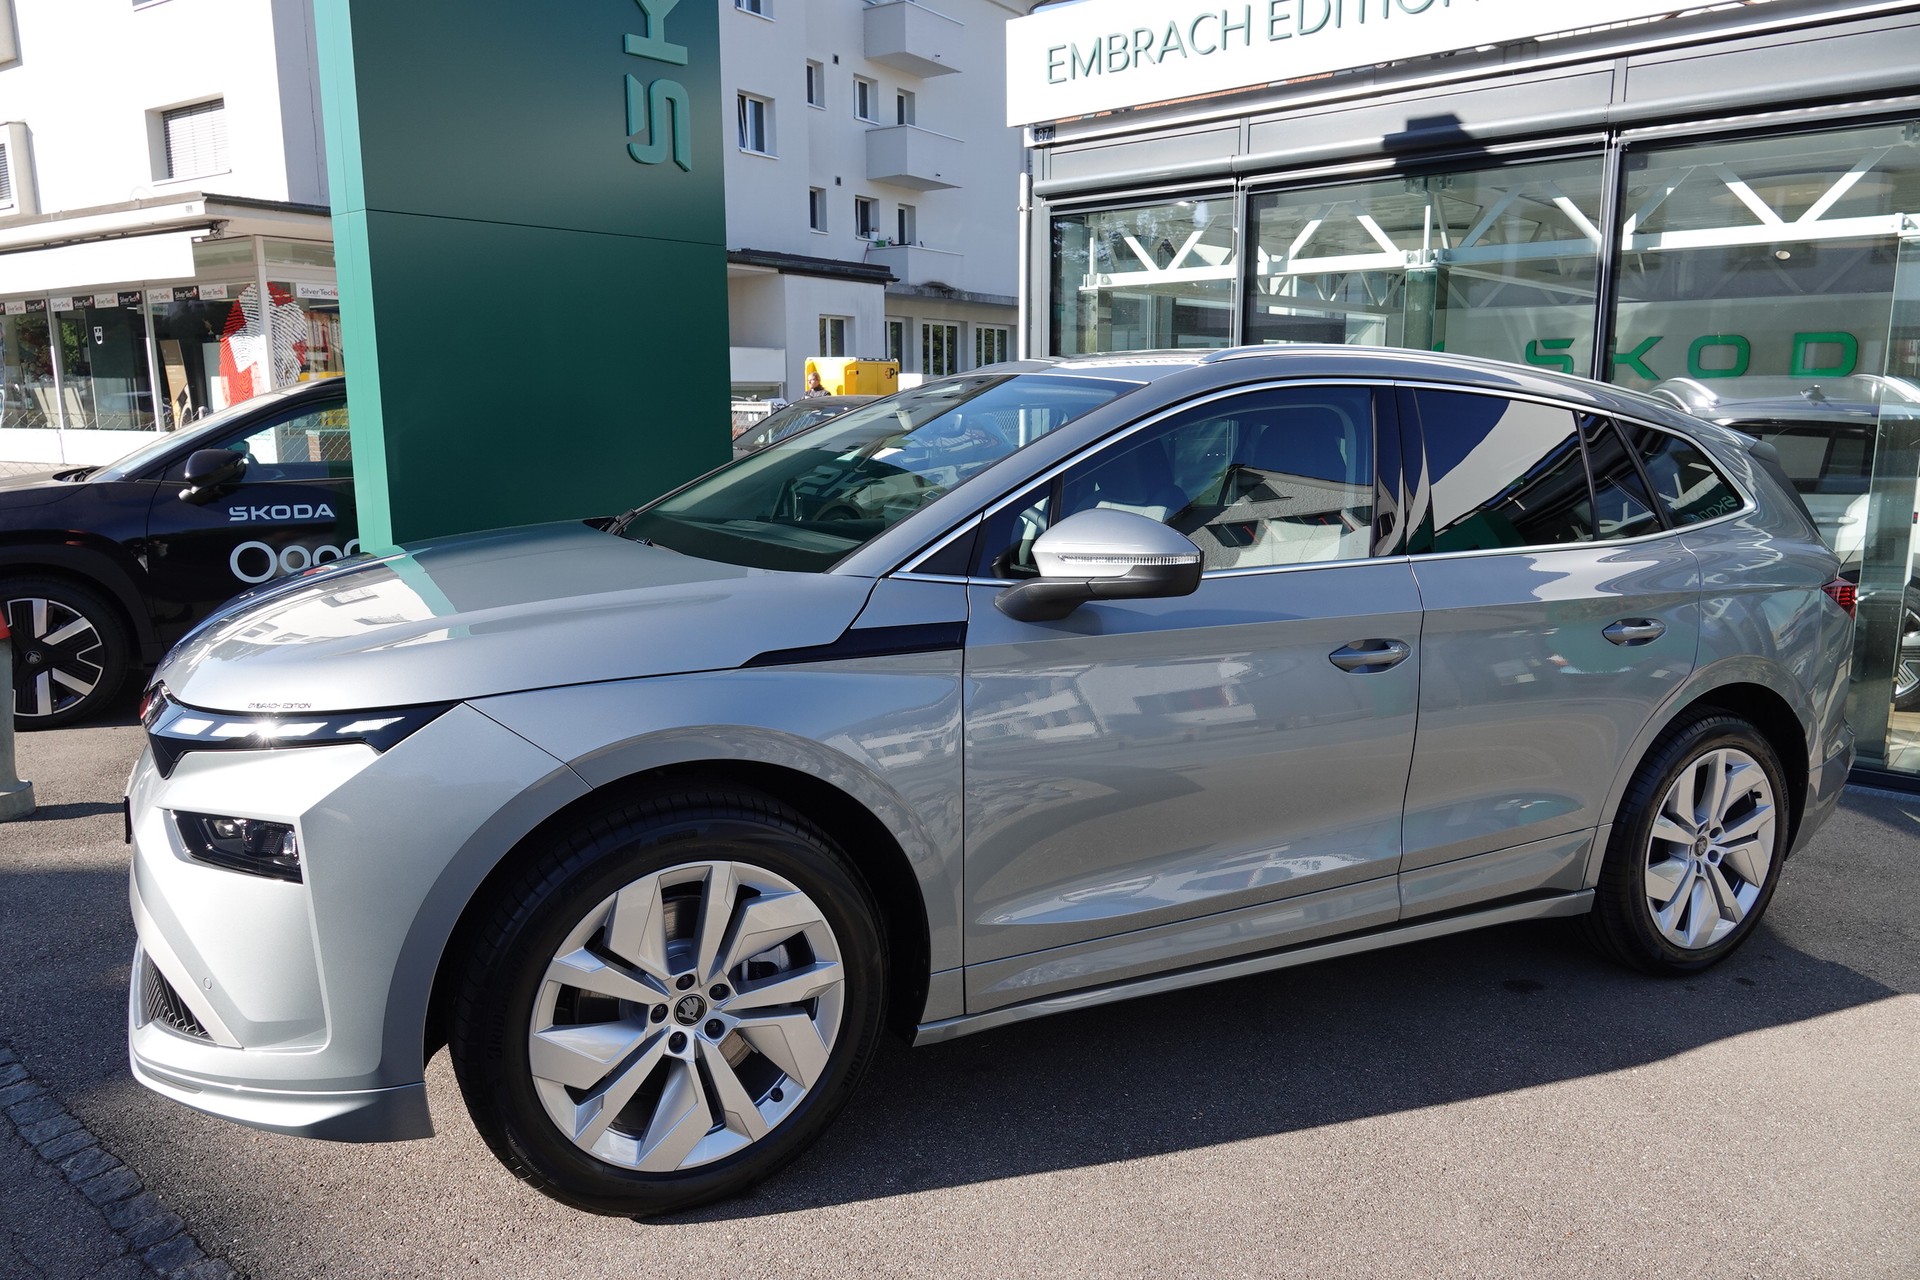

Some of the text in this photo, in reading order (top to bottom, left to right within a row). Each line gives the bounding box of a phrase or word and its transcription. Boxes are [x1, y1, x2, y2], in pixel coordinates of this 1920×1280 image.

[1046, 0, 1478, 84] EMBRACH EDII
[1038, 128, 1050, 141] 87
[229, 538, 360, 584] Ooo
